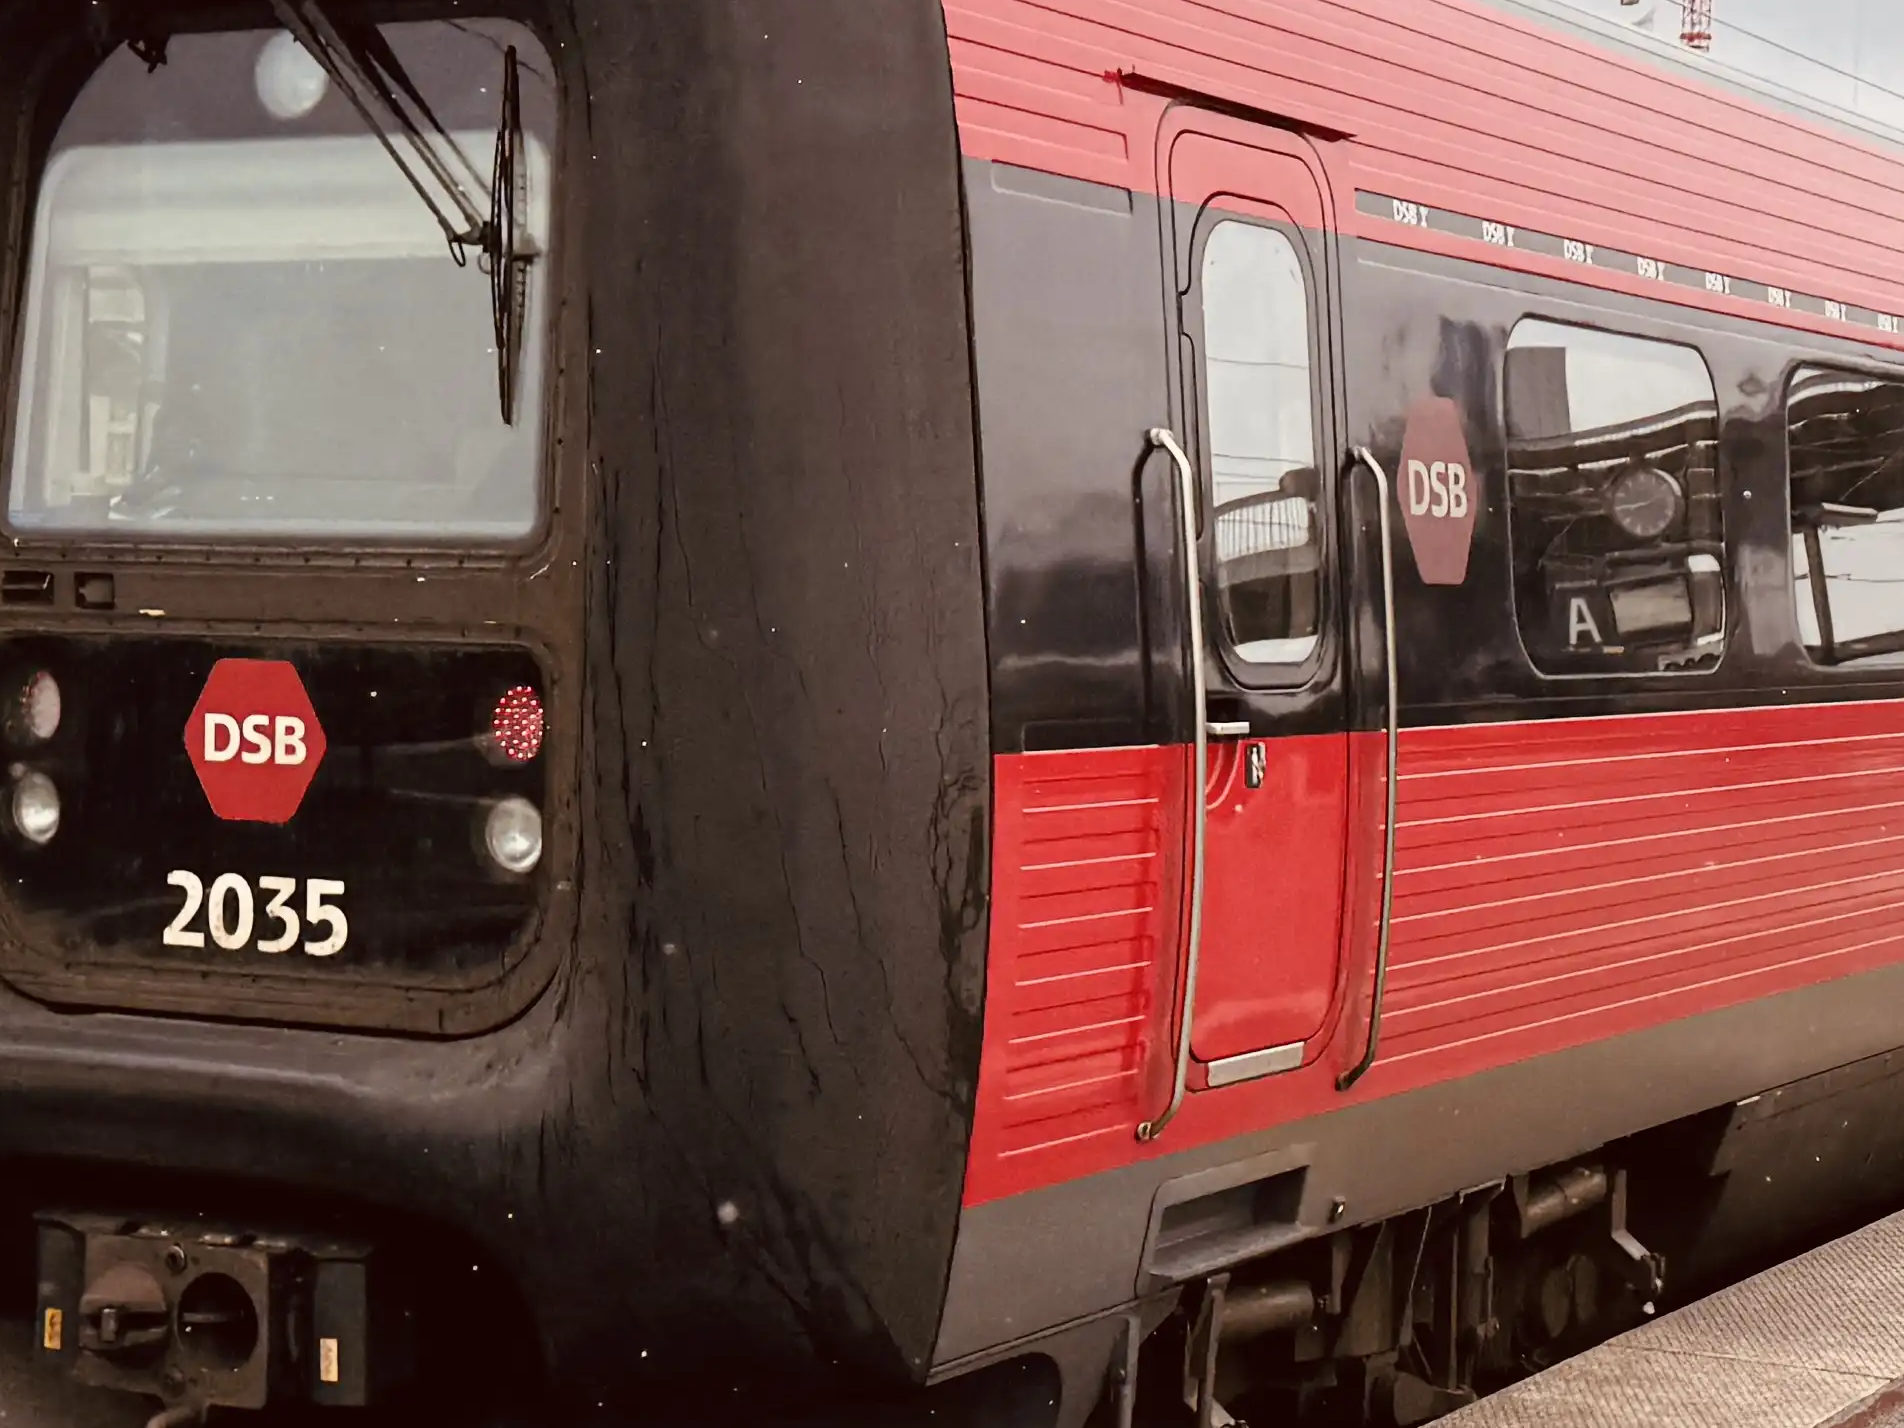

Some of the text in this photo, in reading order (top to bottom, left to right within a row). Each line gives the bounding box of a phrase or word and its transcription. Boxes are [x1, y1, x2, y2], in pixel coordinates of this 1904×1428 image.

[1407, 458, 1468, 519] DSB
[203, 712, 307, 766] DSB
[162, 869, 349, 958] 2035
